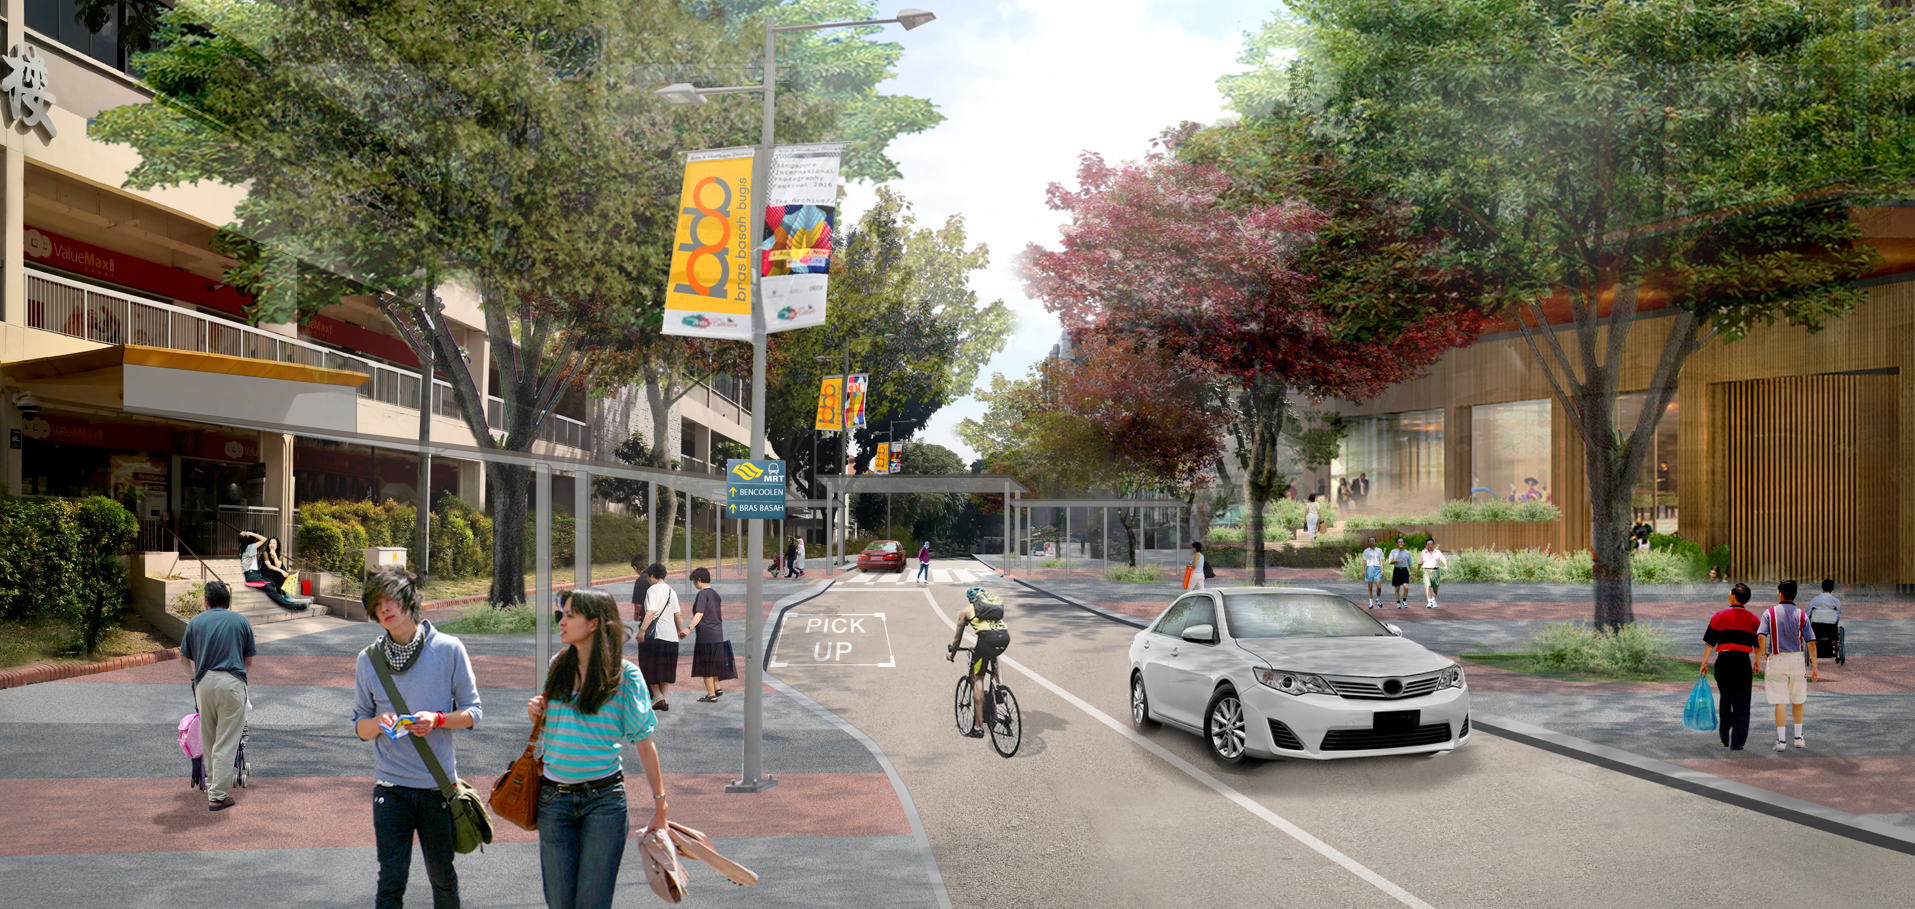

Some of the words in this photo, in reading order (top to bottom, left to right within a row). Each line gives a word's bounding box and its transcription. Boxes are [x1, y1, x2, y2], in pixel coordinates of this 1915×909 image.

[1, 43, 57, 138] 楼
[734, 264, 747, 302] bras
[138, 473, 165, 482] Remittance
[145, 483, 165, 491] Services
[739, 488, 784, 496] BENCOOLEN
[739, 504, 758, 512] BRAS
[759, 504, 784, 512] BASAH
[805, 618, 867, 633] PICK
[813, 641, 853, 662] UP
